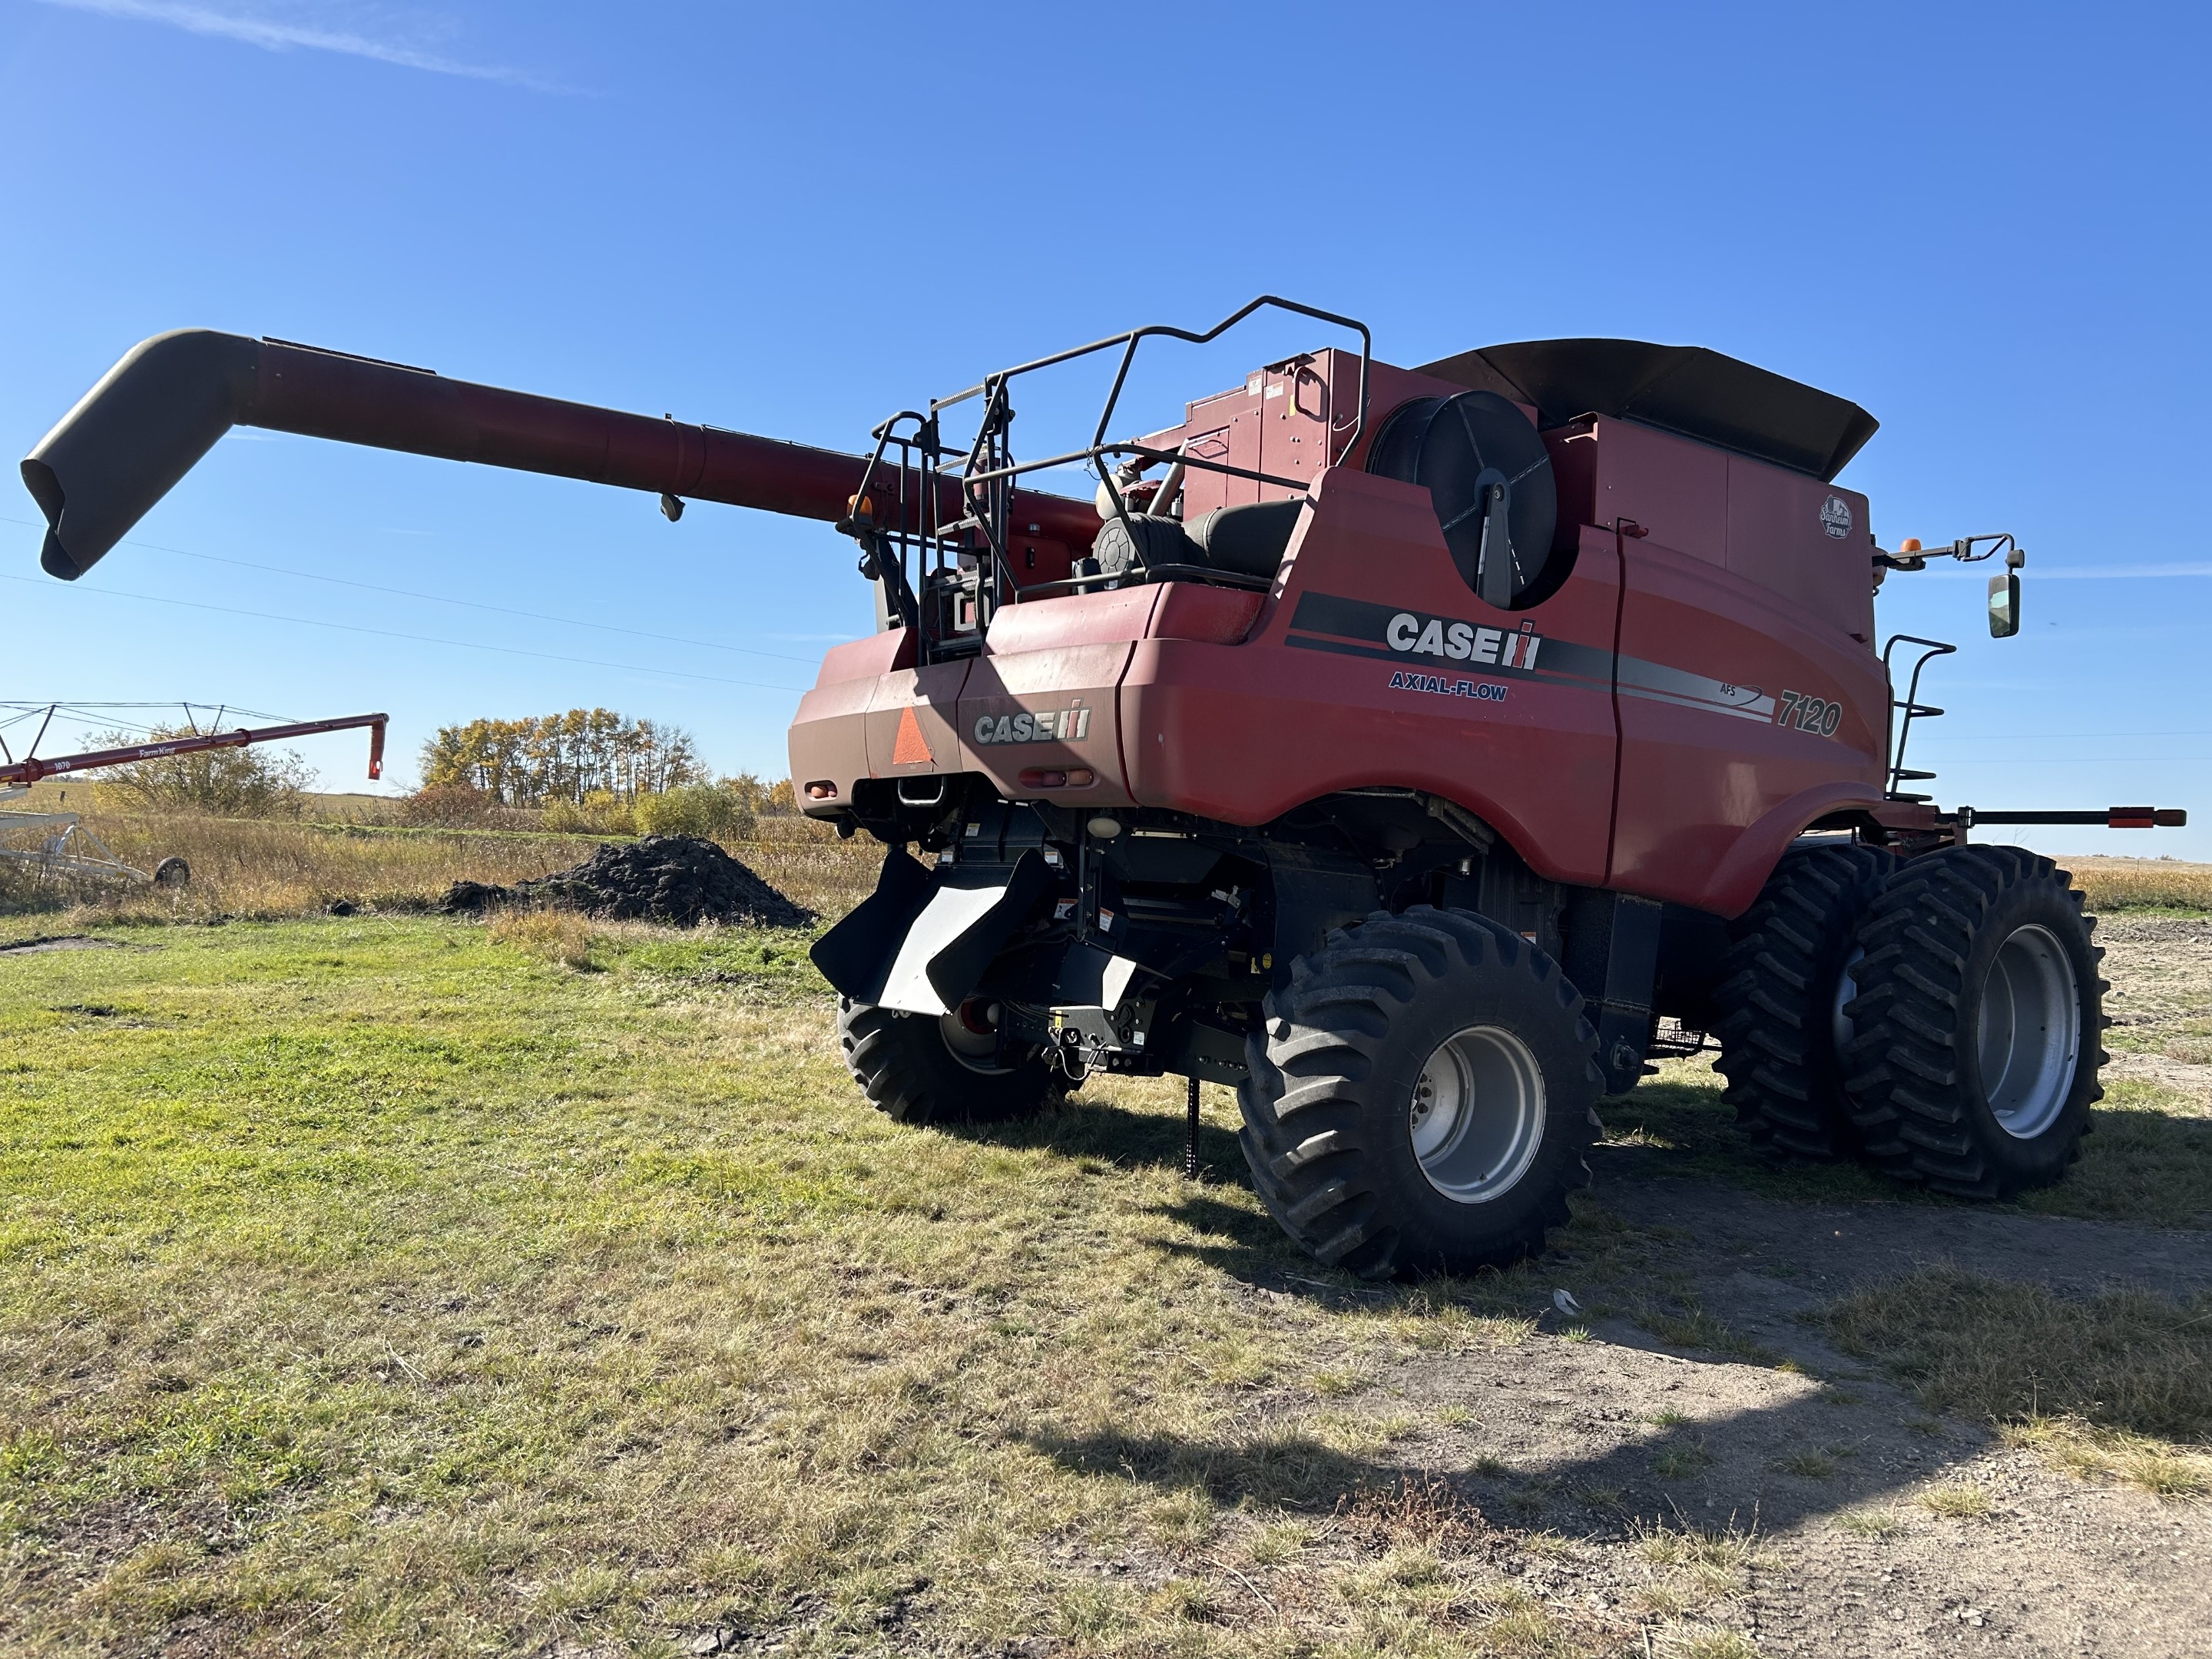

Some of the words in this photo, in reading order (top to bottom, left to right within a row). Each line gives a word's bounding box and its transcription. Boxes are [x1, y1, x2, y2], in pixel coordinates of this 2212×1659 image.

[1826, 522, 1846, 536] Farms
[1386, 614, 1502, 664] CASE
[1389, 671, 1508, 702] AXIAL-FLOW
[1720, 683, 1736, 697] AFS
[974, 713, 1055, 744] CASE
[1778, 690, 1843, 737] 7120
[54, 760, 71, 771] 1070
